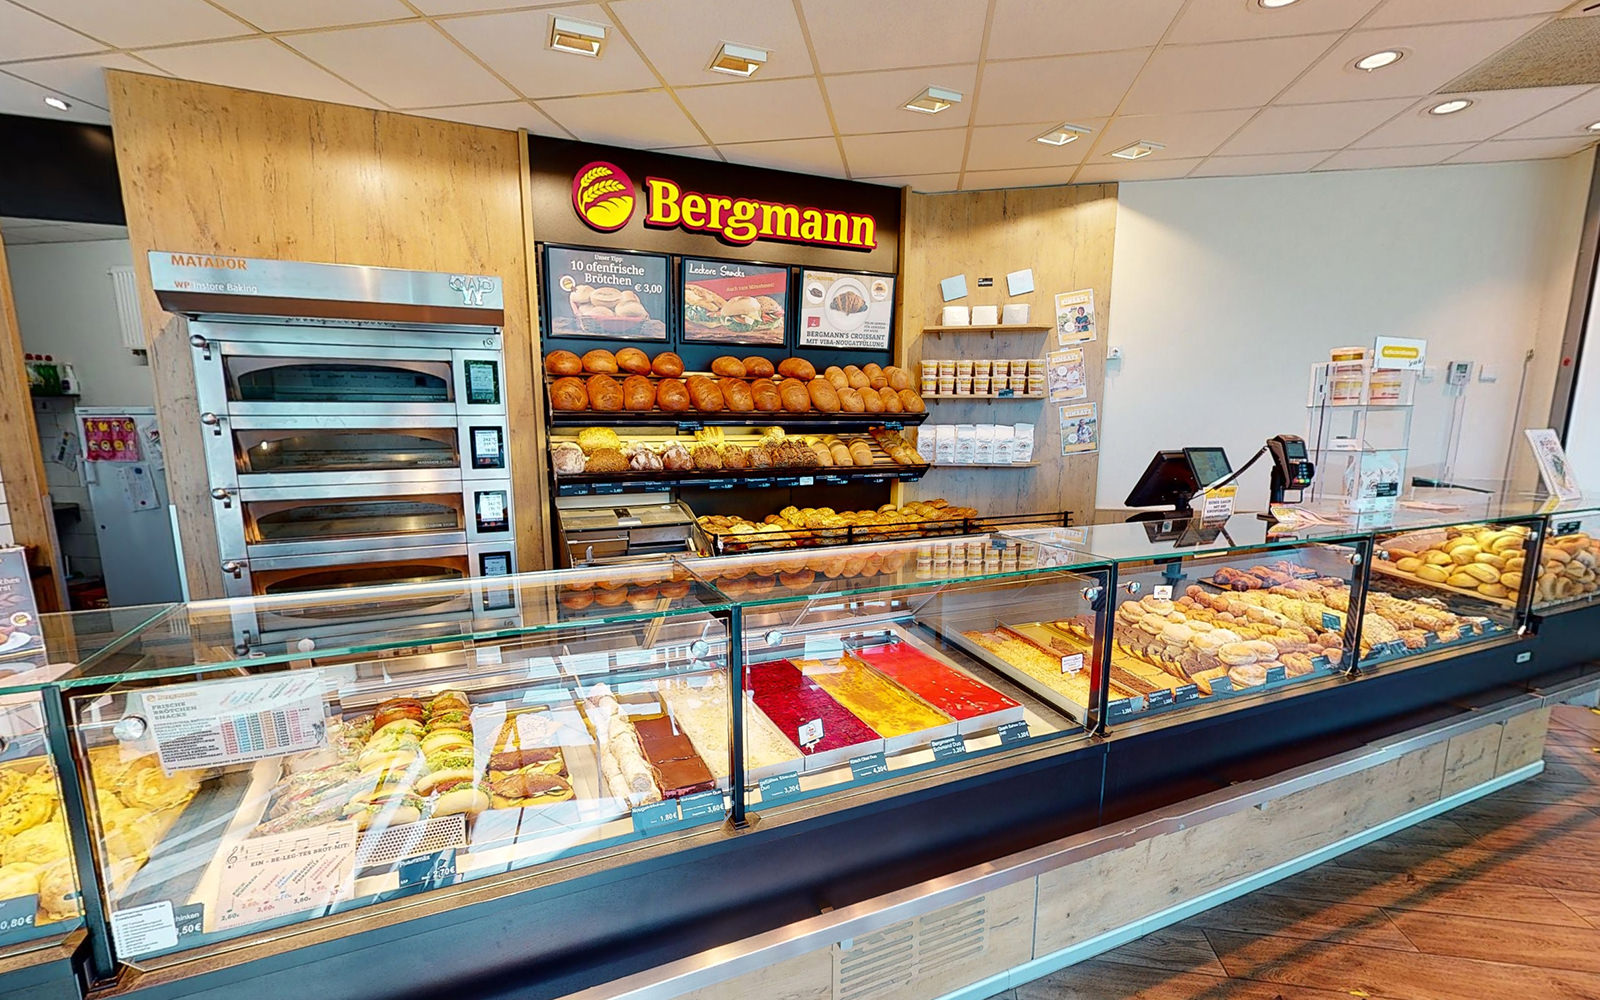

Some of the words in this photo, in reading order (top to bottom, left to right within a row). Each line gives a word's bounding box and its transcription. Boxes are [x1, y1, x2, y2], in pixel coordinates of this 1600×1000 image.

[647, 177, 877, 248] Bergmann
[171, 254, 247, 270] MATADOR
[570, 260, 584, 271] 10
[586, 262, 645, 276] ofenfrische
[720, 265, 745, 278] Snacks
[584, 272, 632, 286] Brötchen
[174, 281, 190, 289] WP
[193, 281, 225, 291] Instore
[226, 283, 257, 294] Baking
[850, 333, 885, 341] CROISSANT
[0, 914, 33, 930] 0,80€
[175, 912, 200, 922] hinken
